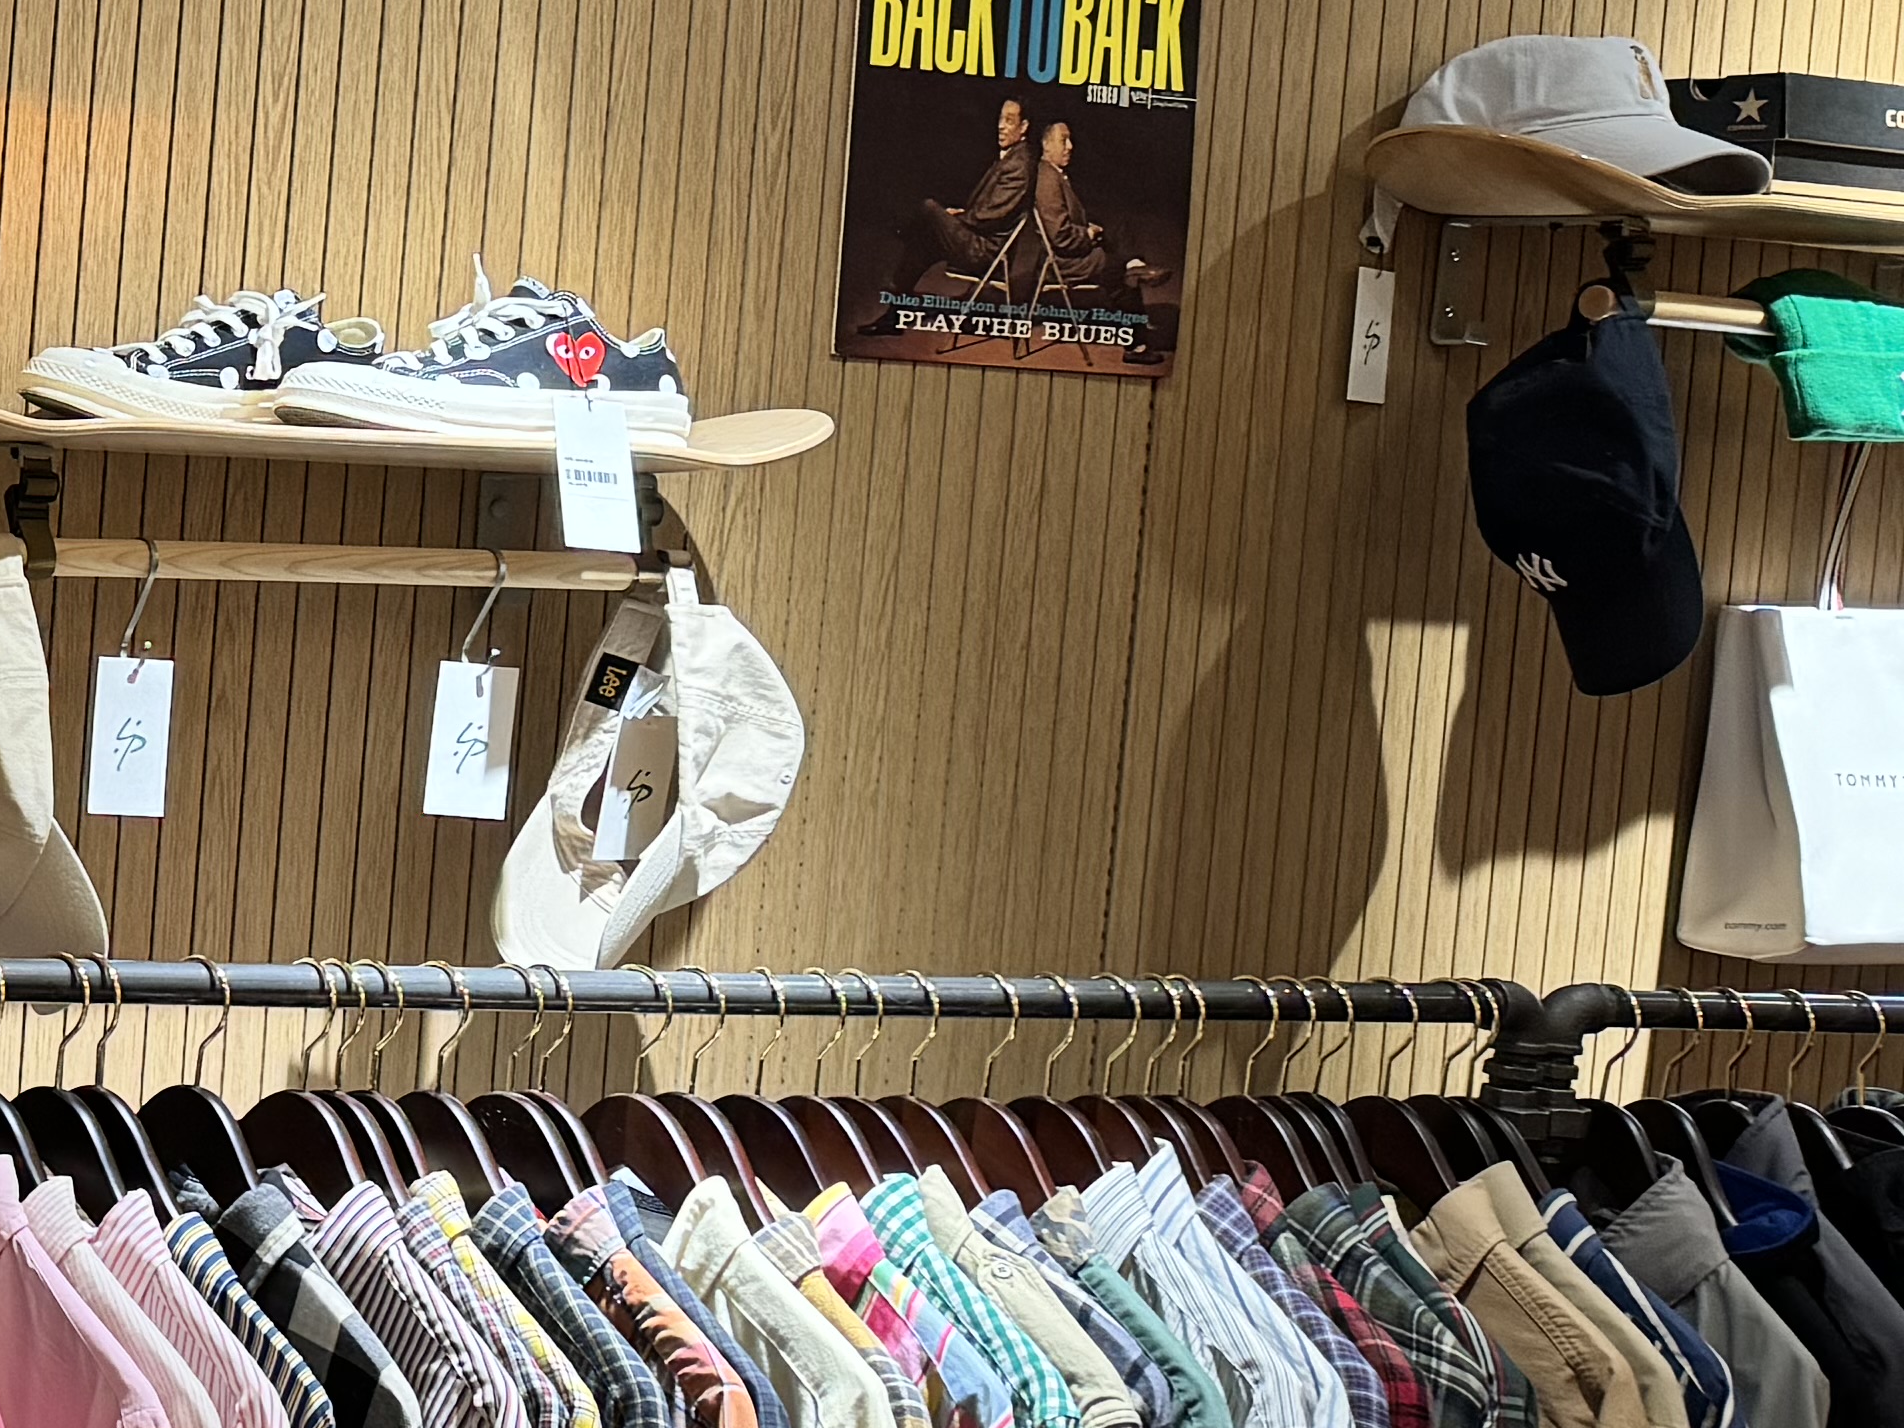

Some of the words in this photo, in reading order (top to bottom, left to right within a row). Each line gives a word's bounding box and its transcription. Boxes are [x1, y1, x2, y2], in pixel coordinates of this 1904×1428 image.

[1087, 84, 1118, 104] STEREO
[879, 291, 919, 307] Duke
[922, 294, 995, 316] Ellington
[998, 301, 1027, 318] and
[1029, 302, 1088, 323] Johnny
[1091, 307, 1149, 327] Hodges
[895, 310, 962, 334] PLAY
[971, 317, 1032, 339] THE
[1042, 321, 1134, 346] BLUES
[598, 665, 628, 698] Lee
[1834, 773, 1897, 789] TOMMY
